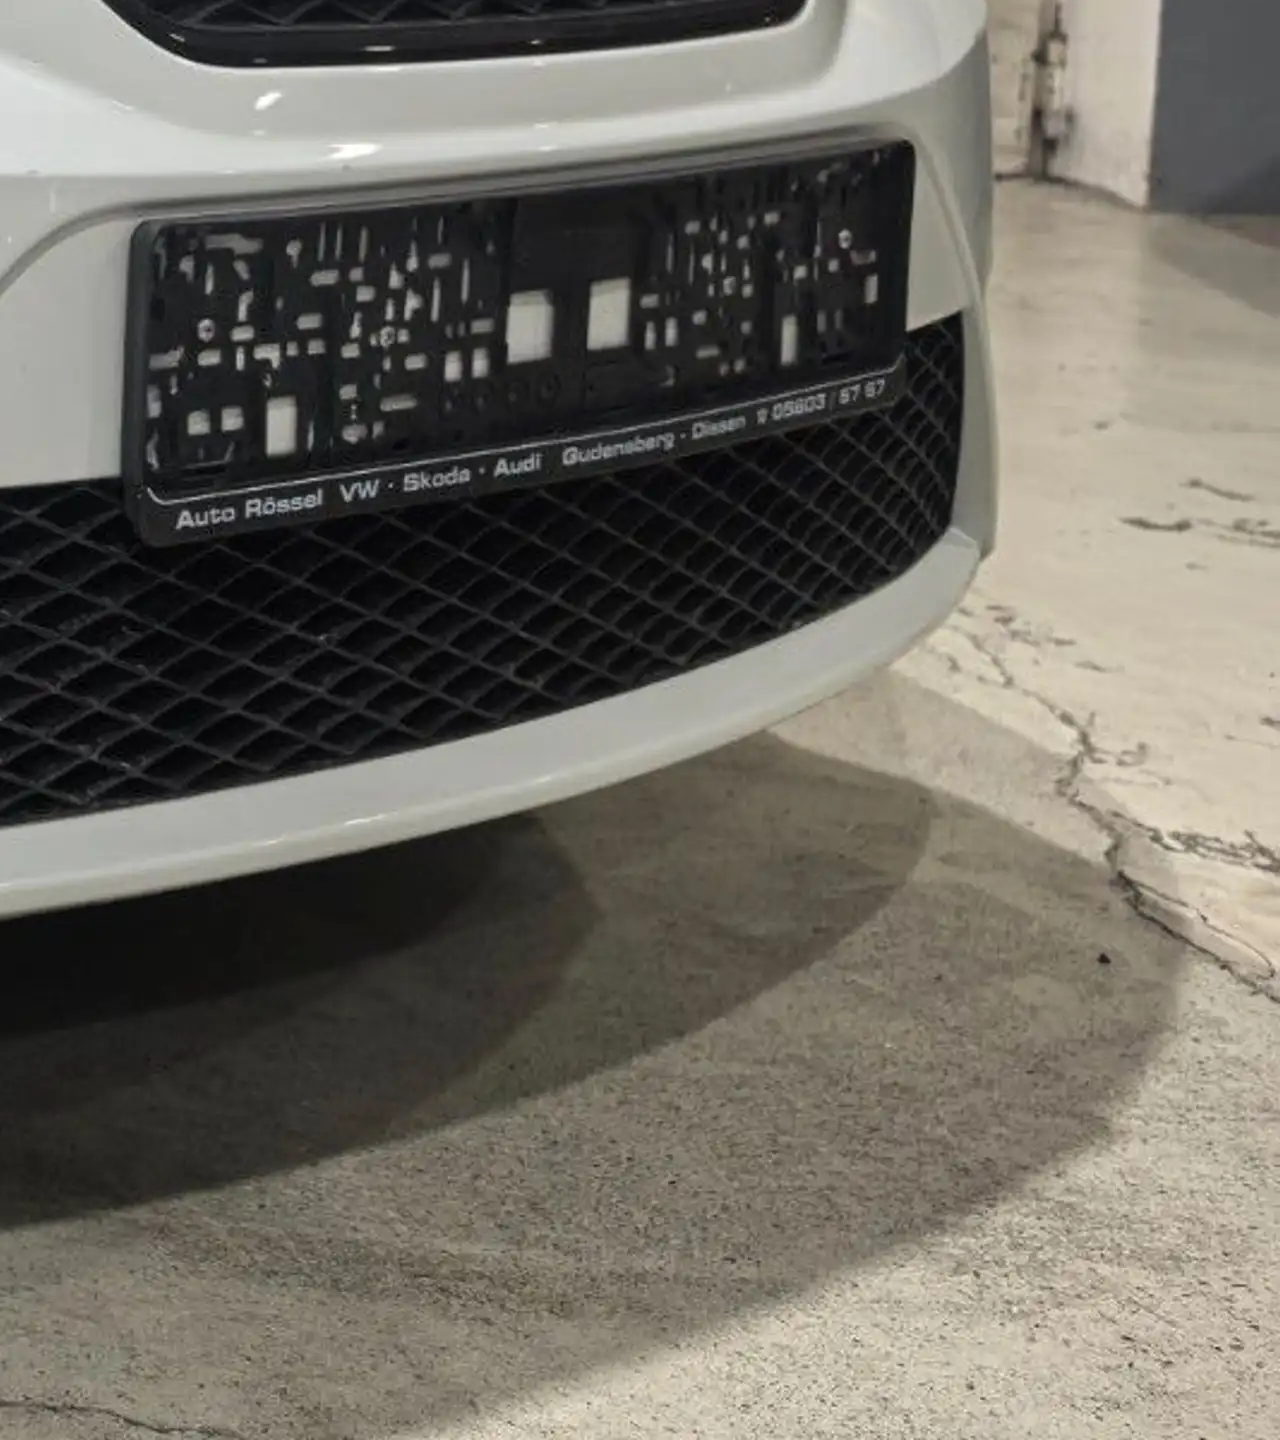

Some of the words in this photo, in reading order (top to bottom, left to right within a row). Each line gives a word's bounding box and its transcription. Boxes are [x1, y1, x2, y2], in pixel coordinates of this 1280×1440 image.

[175, 507, 236, 531] Auto
[244, 488, 324, 520] Rössel
[339, 479, 381, 504] VW
[402, 467, 472, 493] Skoda
[492, 452, 544, 479] Audi
[561, 431, 676, 467] Gudensberg
